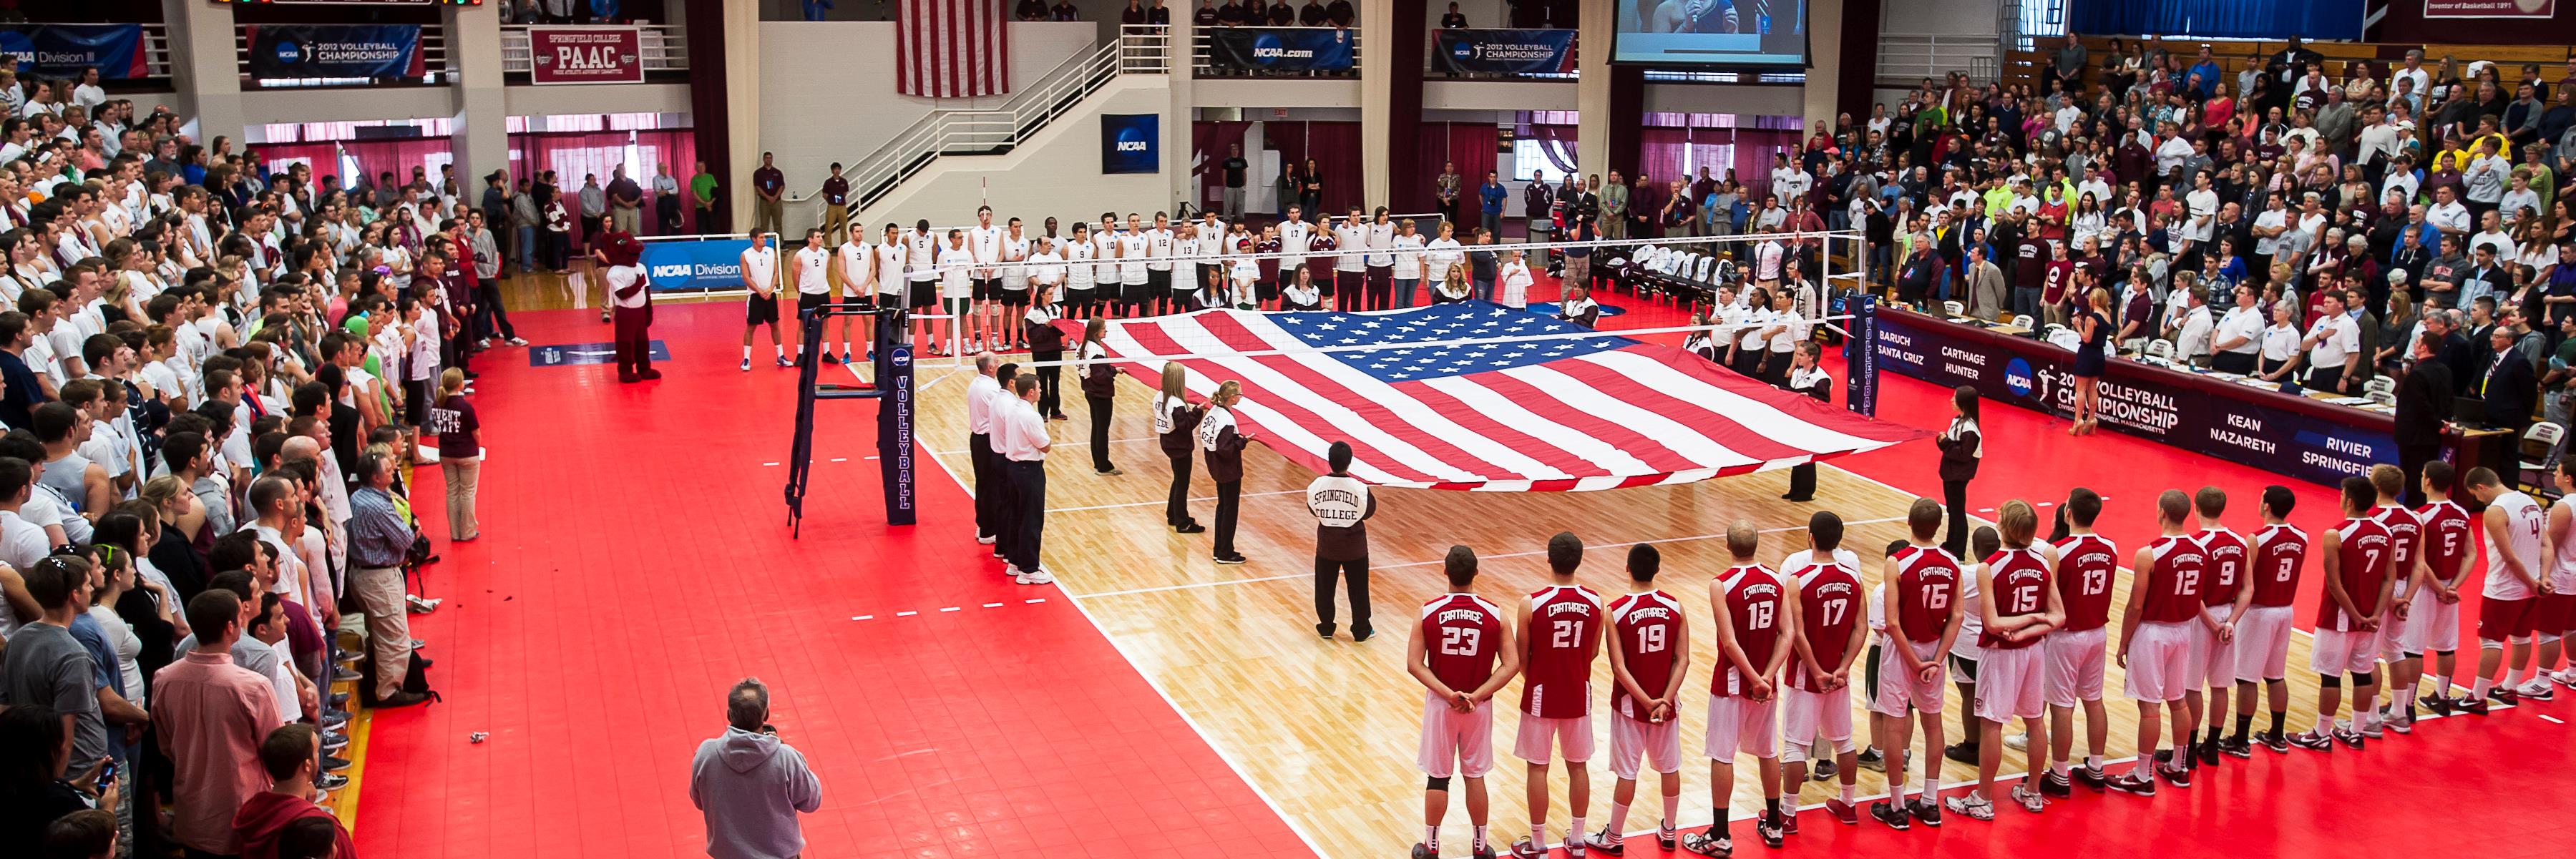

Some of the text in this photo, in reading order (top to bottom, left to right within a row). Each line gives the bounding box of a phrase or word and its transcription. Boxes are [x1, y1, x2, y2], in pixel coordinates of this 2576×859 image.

[339, 42, 398, 51] VOLLEYBALL
[549, 34, 622, 43] SPRINGFIELD COLLEGE
[39, 51, 95, 63] Division III
[318, 51, 400, 61] CHAMPIONSHIP
[557, 46, 617, 69] PAAC
[1254, 48, 1313, 58] NCAA.com
[1117, 141, 1146, 152] NCAA
[1183, 246, 1192, 255] 13
[653, 264, 692, 278] NCAA
[695, 264, 740, 275] Division
[759, 258, 763, 267] 1
[1879, 330, 1911, 347] BARUCH
[1878, 344, 1924, 365] SANTA CRUZ
[1941, 345, 1986, 365] CARTHAGE
[1863, 317, 1873, 417] VOLLEYBAL
[1945, 363, 1979, 381] HUNTER
[2006, 373, 2032, 390] NCAA
[2057, 388, 2178, 430] CHPIONSHIP
[2057, 403, 2076, 413] DIVISIO
[2120, 419, 2165, 435] MASSACHUSETTS
[2227, 413, 2261, 432] KEAN
[897, 375, 910, 509] VOLLEYBALL
[2210, 428, 2276, 455] NAZARETH
[2326, 436, 2372, 458] RIVIER
[2302, 451, 2373, 478] SPRINGFIE
[1314, 489, 1359, 508] SPRINGFIELD
[1315, 509, 1357, 520] COLLEGE
[2529, 517, 2540, 540] 4
[2273, 541, 2302, 556] CARTHAGE
[2357, 534, 2389, 550] CARTHAGE
[2395, 538, 2409, 561] 6
[2444, 532, 2457, 556] 5
[2077, 551, 2111, 568] CARTHAGE
[2172, 552, 2204, 569] CARTHAGE
[2212, 544, 2243, 561] CARTHAGE
[2364, 549, 2379, 573] 7
[1919, 566, 1953, 582] CARTHAGE
[2009, 568, 2044, 585] CARTHAGE
[2219, 561, 2235, 586] 9
[2276, 557, 2293, 582] 8
[1742, 583, 1778, 601] CARTHAGE
[1816, 581, 1852, 599] CARTHAGE
[2082, 569, 2107, 596] 13
[2173, 569, 2200, 596] 12
[1921, 583, 1950, 609] 16
[2011, 585, 2039, 613] 15
[1438, 609, 1483, 625] CARTHAGE
[1547, 601, 1590, 618] CARTHAGE
[1629, 607, 1670, 626] CARTHAGE
[1747, 599, 1775, 631] 18
[1823, 598, 1848, 627] 17
[1440, 627, 1481, 657] 23
[1552, 620, 1584, 649] 21
[1636, 624, 1666, 654] 19
